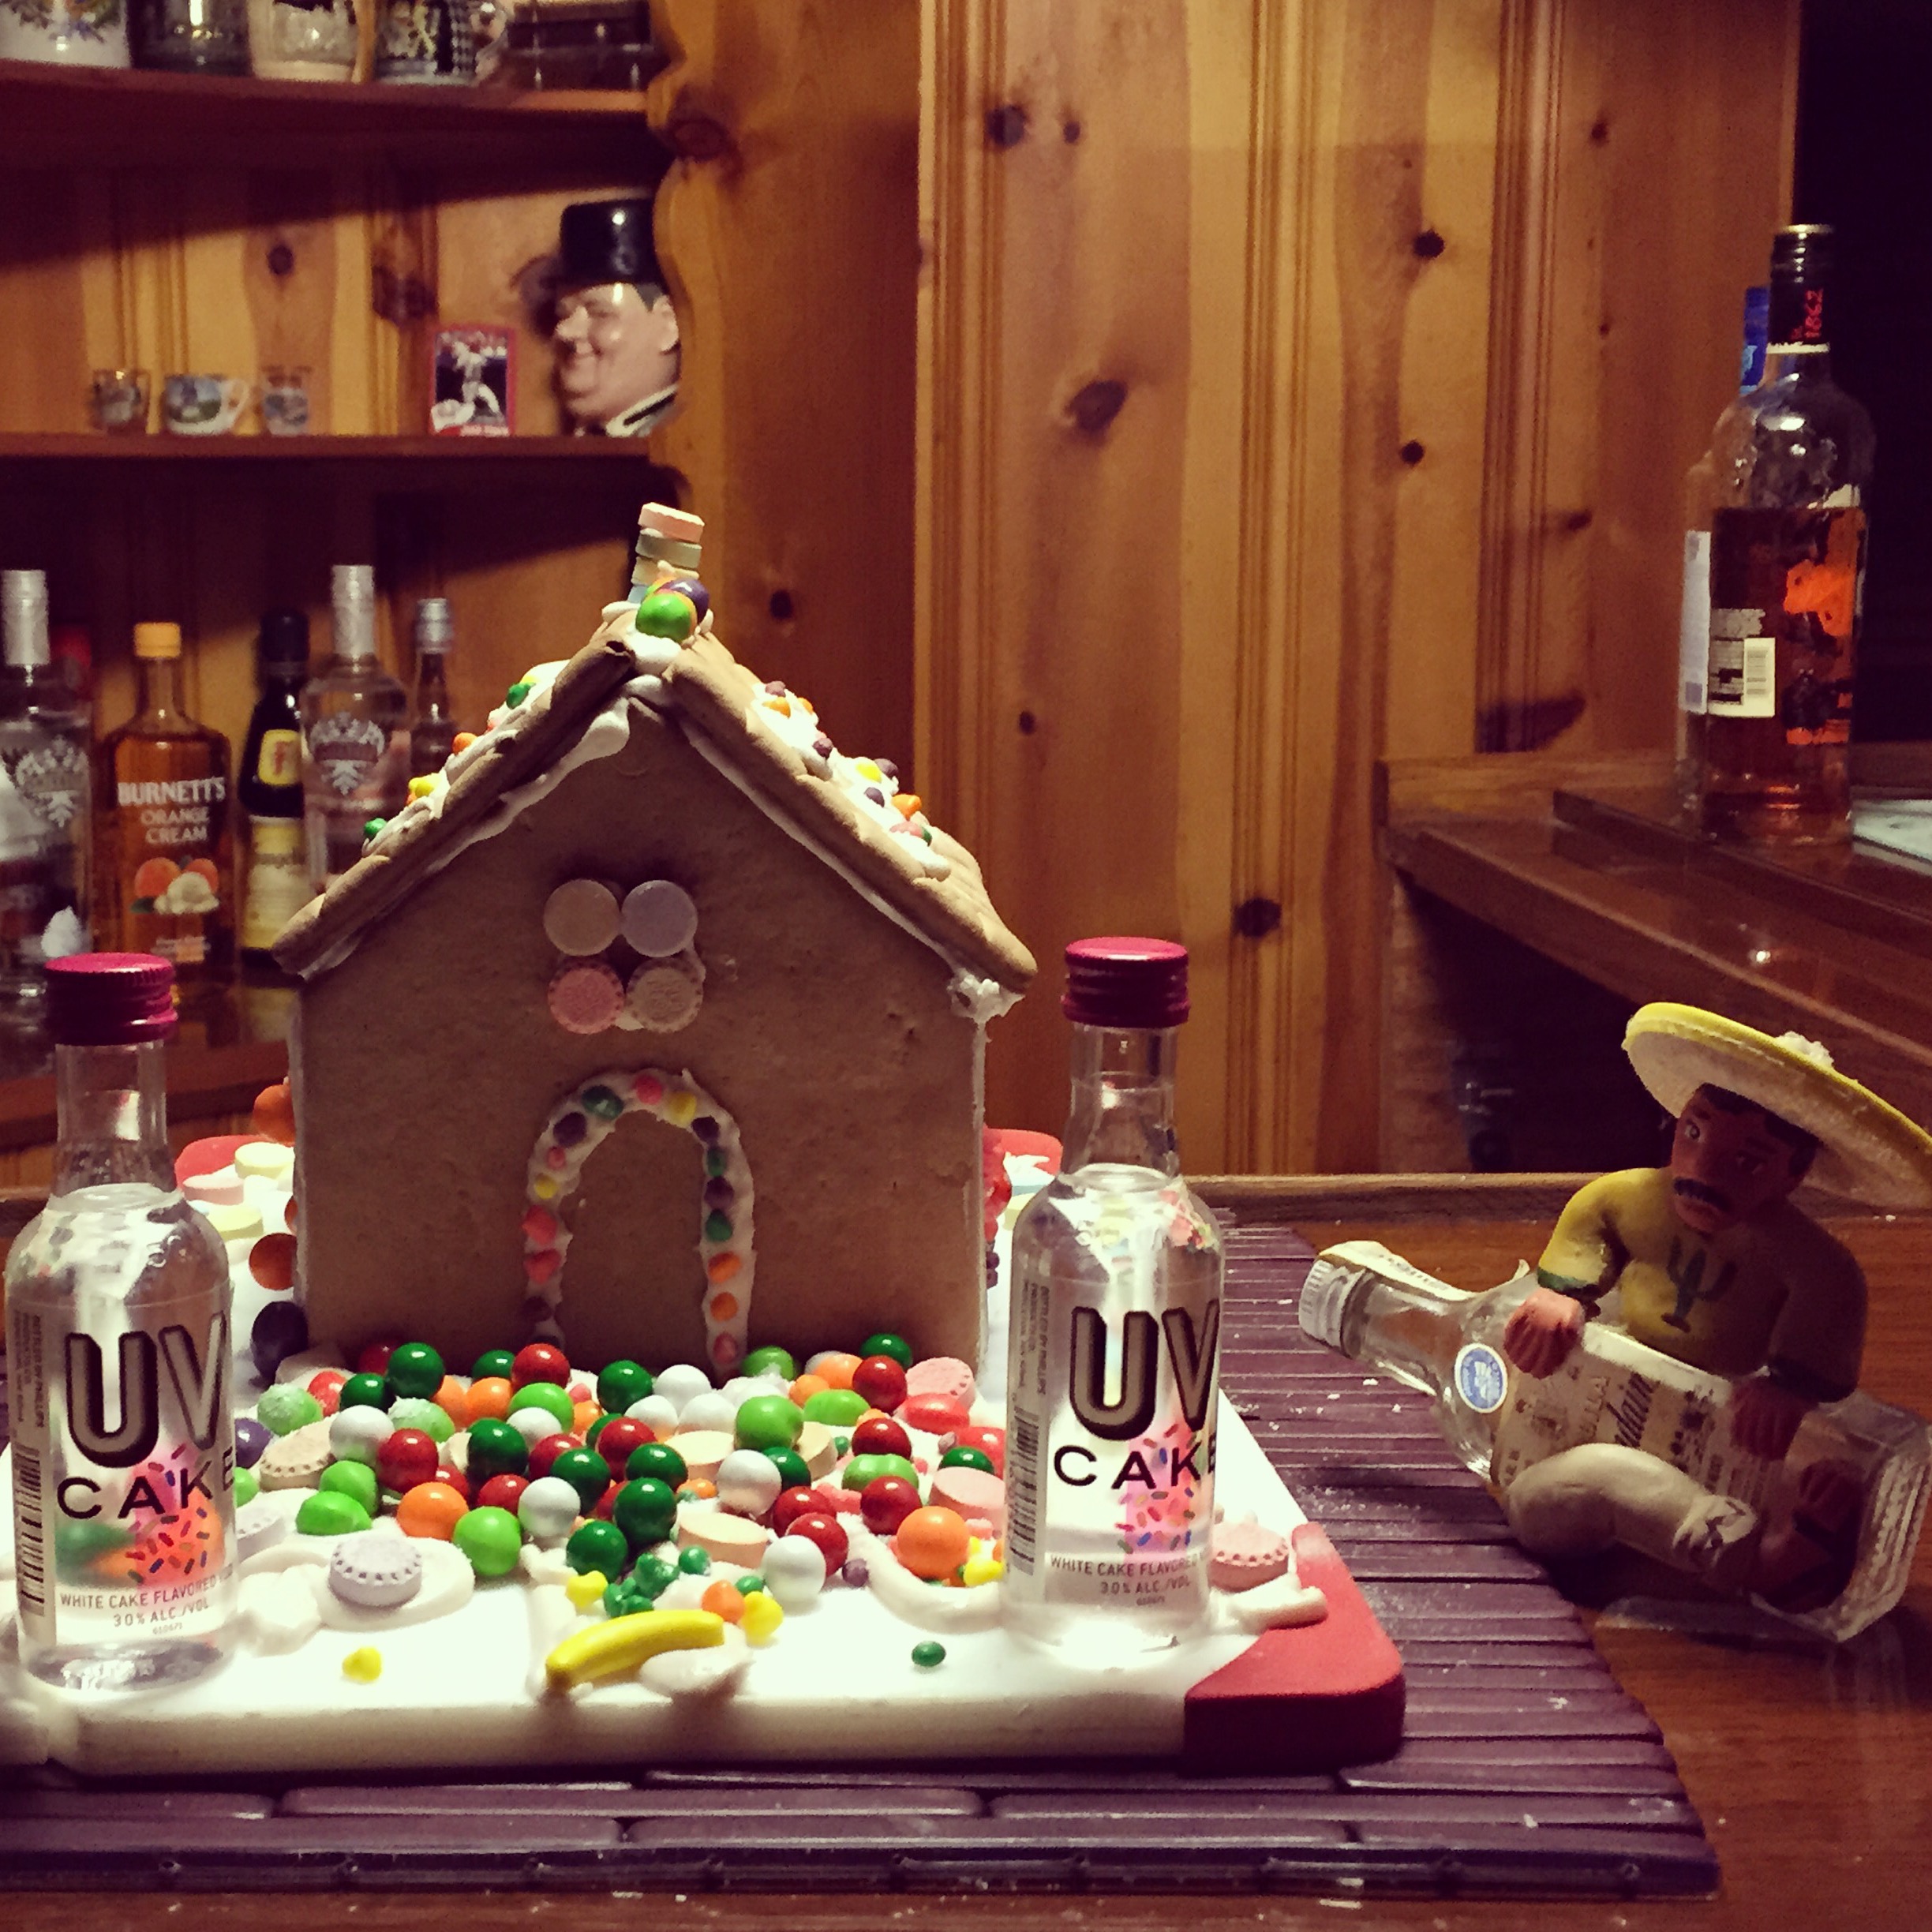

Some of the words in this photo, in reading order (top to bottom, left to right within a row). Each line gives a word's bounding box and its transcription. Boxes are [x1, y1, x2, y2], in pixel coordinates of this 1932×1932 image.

[140, 807, 209, 825] ORANGE
[144, 826, 208, 844] CREAM
[1069, 1299, 1220, 1441] UV
[66, 1312, 227, 1468] UV
[1054, 1432, 1216, 1491] CAKE
[57, 1446, 234, 1519] CAKE
[1050, 1555, 1092, 1574] WHITE
[1097, 1562, 1134, 1577] CAKE
[1140, 1553, 1198, 1576] FLAVORED
[60, 1593, 103, 1609] WHITE
[109, 1591, 148, 1608] CAKE
[153, 1575, 217, 1604] FLAVORED
[113, 1613, 145, 1627] 30%
